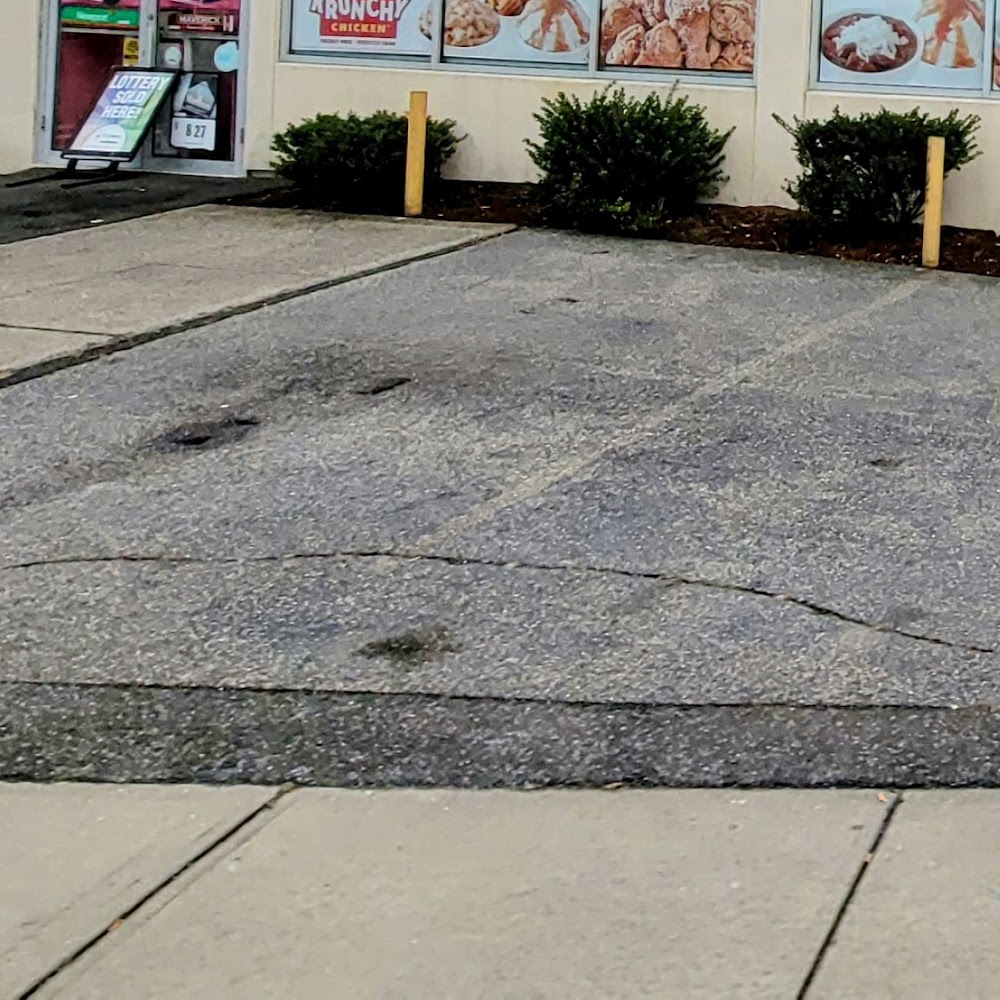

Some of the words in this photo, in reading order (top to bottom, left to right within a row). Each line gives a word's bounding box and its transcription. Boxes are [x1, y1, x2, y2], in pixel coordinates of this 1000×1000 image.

[330, 23, 386, 33] CHICKEN
[108, 75, 171, 91] LOTTERY
[112, 90, 147, 105] SOLD
[100, 104, 144, 120] HERE!
